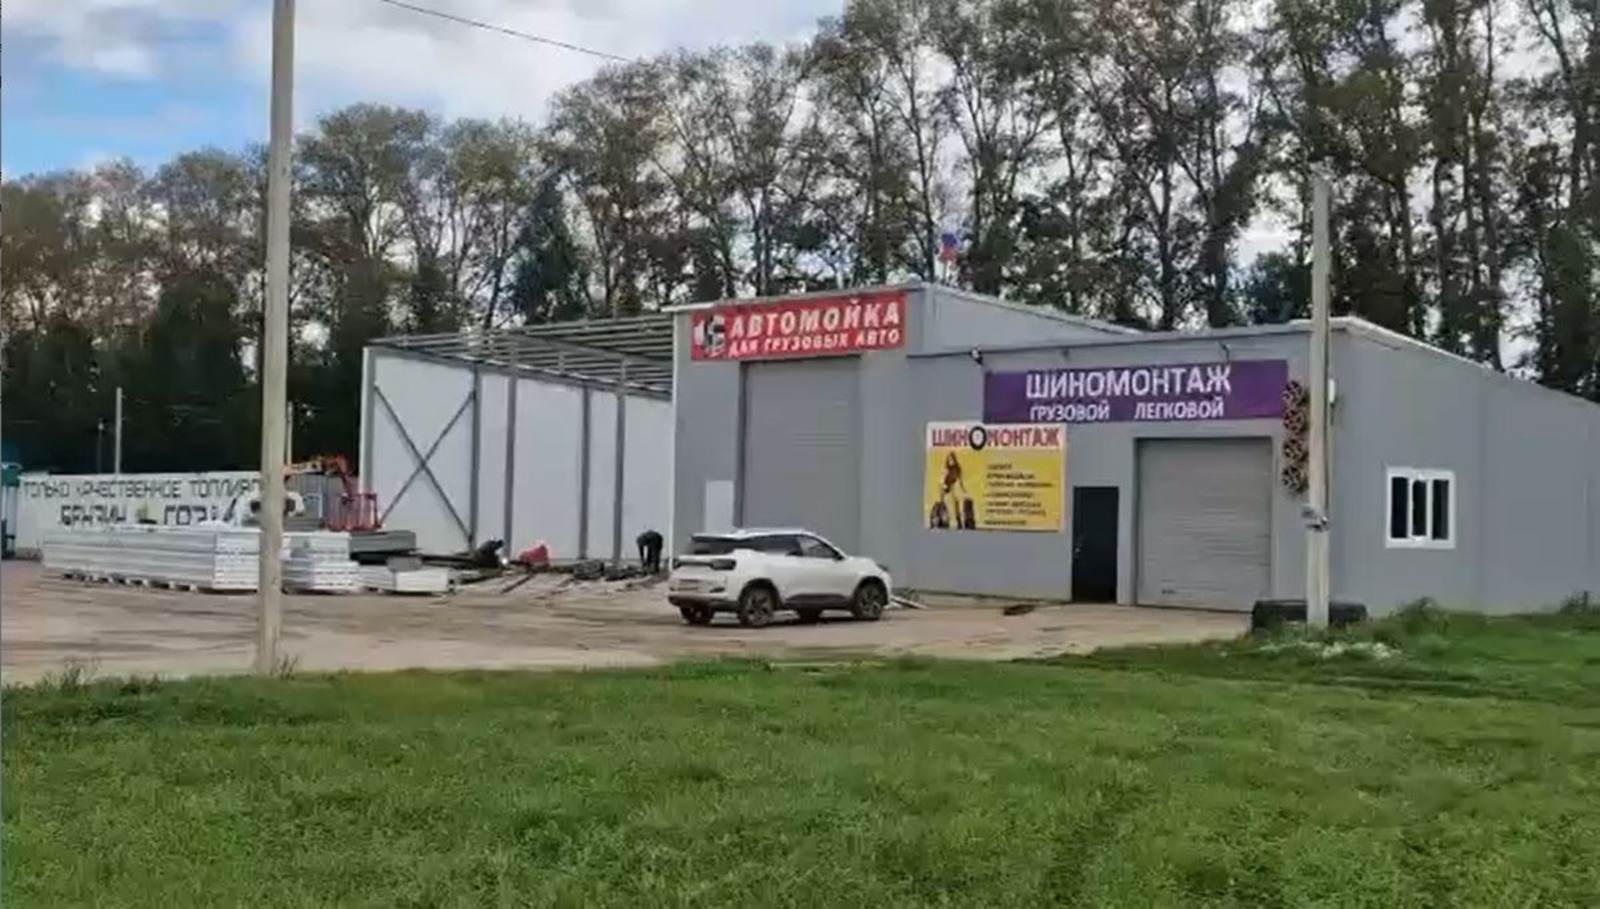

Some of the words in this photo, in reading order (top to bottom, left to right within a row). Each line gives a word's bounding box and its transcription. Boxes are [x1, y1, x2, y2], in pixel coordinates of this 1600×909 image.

[729, 298, 900, 338] АВТОМОЙКА
[728, 339, 760, 358] ДЛЯ
[764, 331, 849, 351] ГРУЗОВЫХ
[855, 328, 900, 346] АВТО
[1025, 364, 1232, 399] ШИНОМОНТАЖ
[1029, 400, 1110, 422] ГРУЗОВОЙ
[1134, 396, 1225, 420] ЛЕГКОВОЙ
